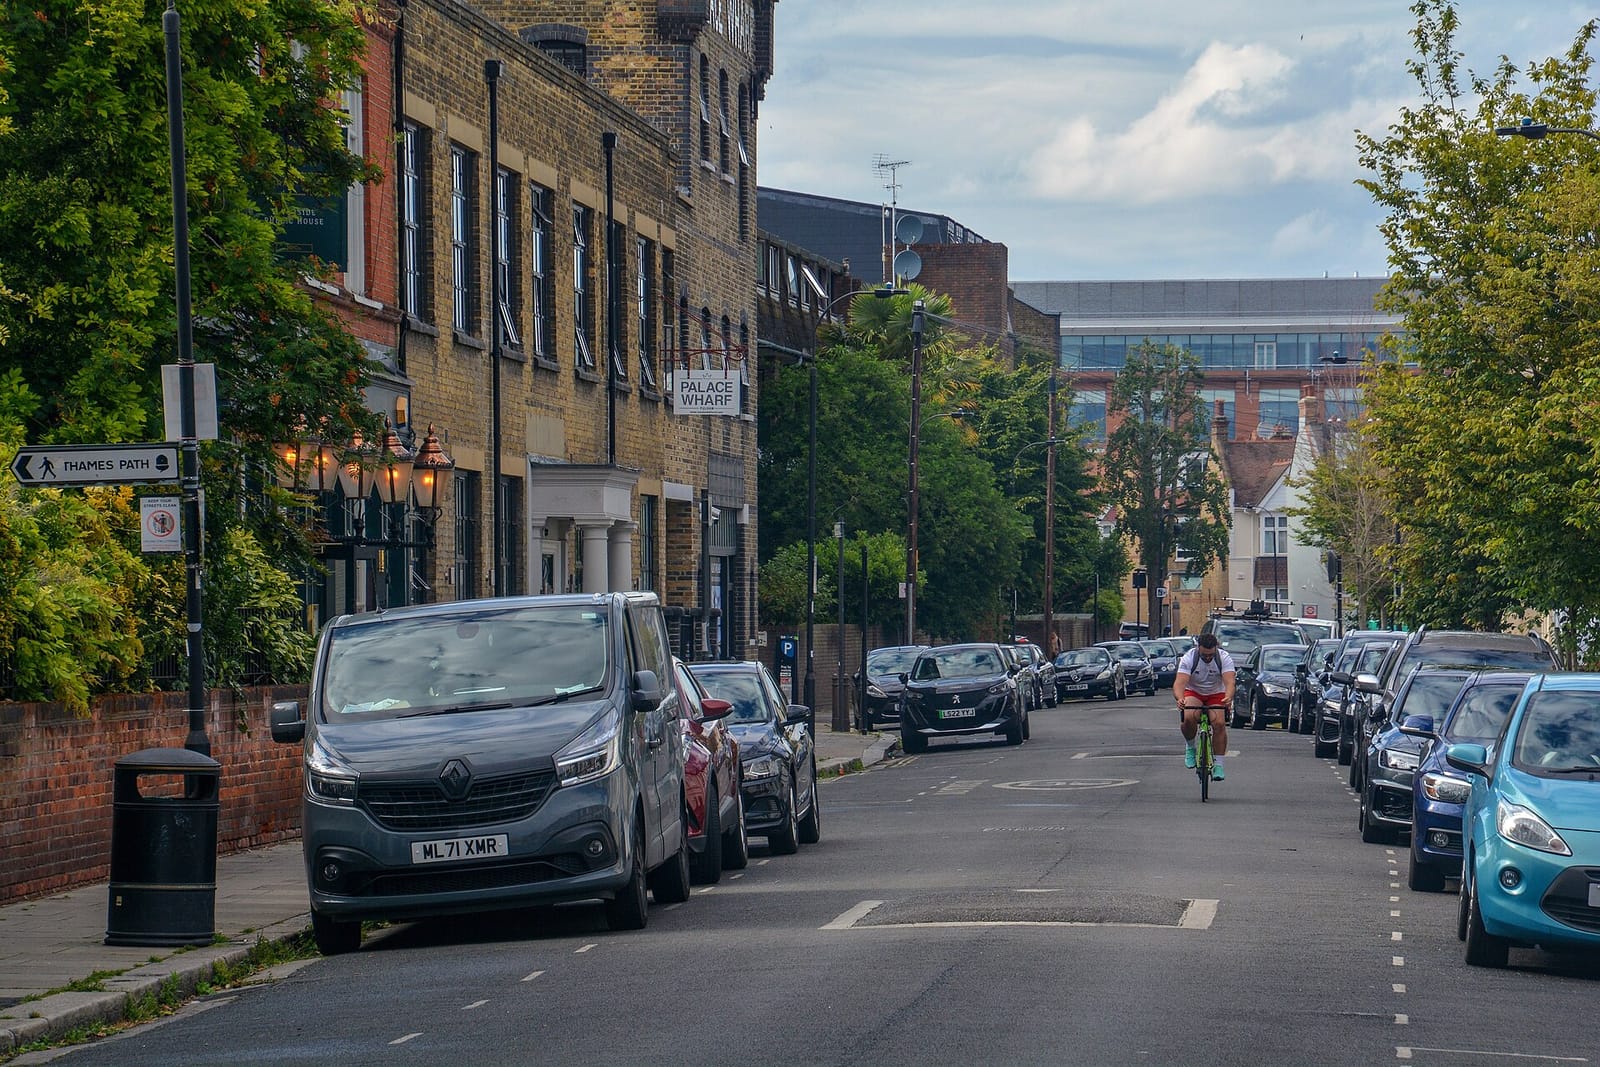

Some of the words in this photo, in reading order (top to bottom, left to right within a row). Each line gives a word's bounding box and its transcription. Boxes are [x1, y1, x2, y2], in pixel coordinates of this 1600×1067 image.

[297, 217, 324, 225] HOUSE
[680, 381, 733, 393] PALACE
[681, 394, 732, 406] WHARF
[64, 458, 114, 472] THAMES
[119, 458, 150, 470] PATH
[784, 642, 793, 655] P
[422, 842, 460, 860] ML71
[465, 838, 498, 856] XMR
